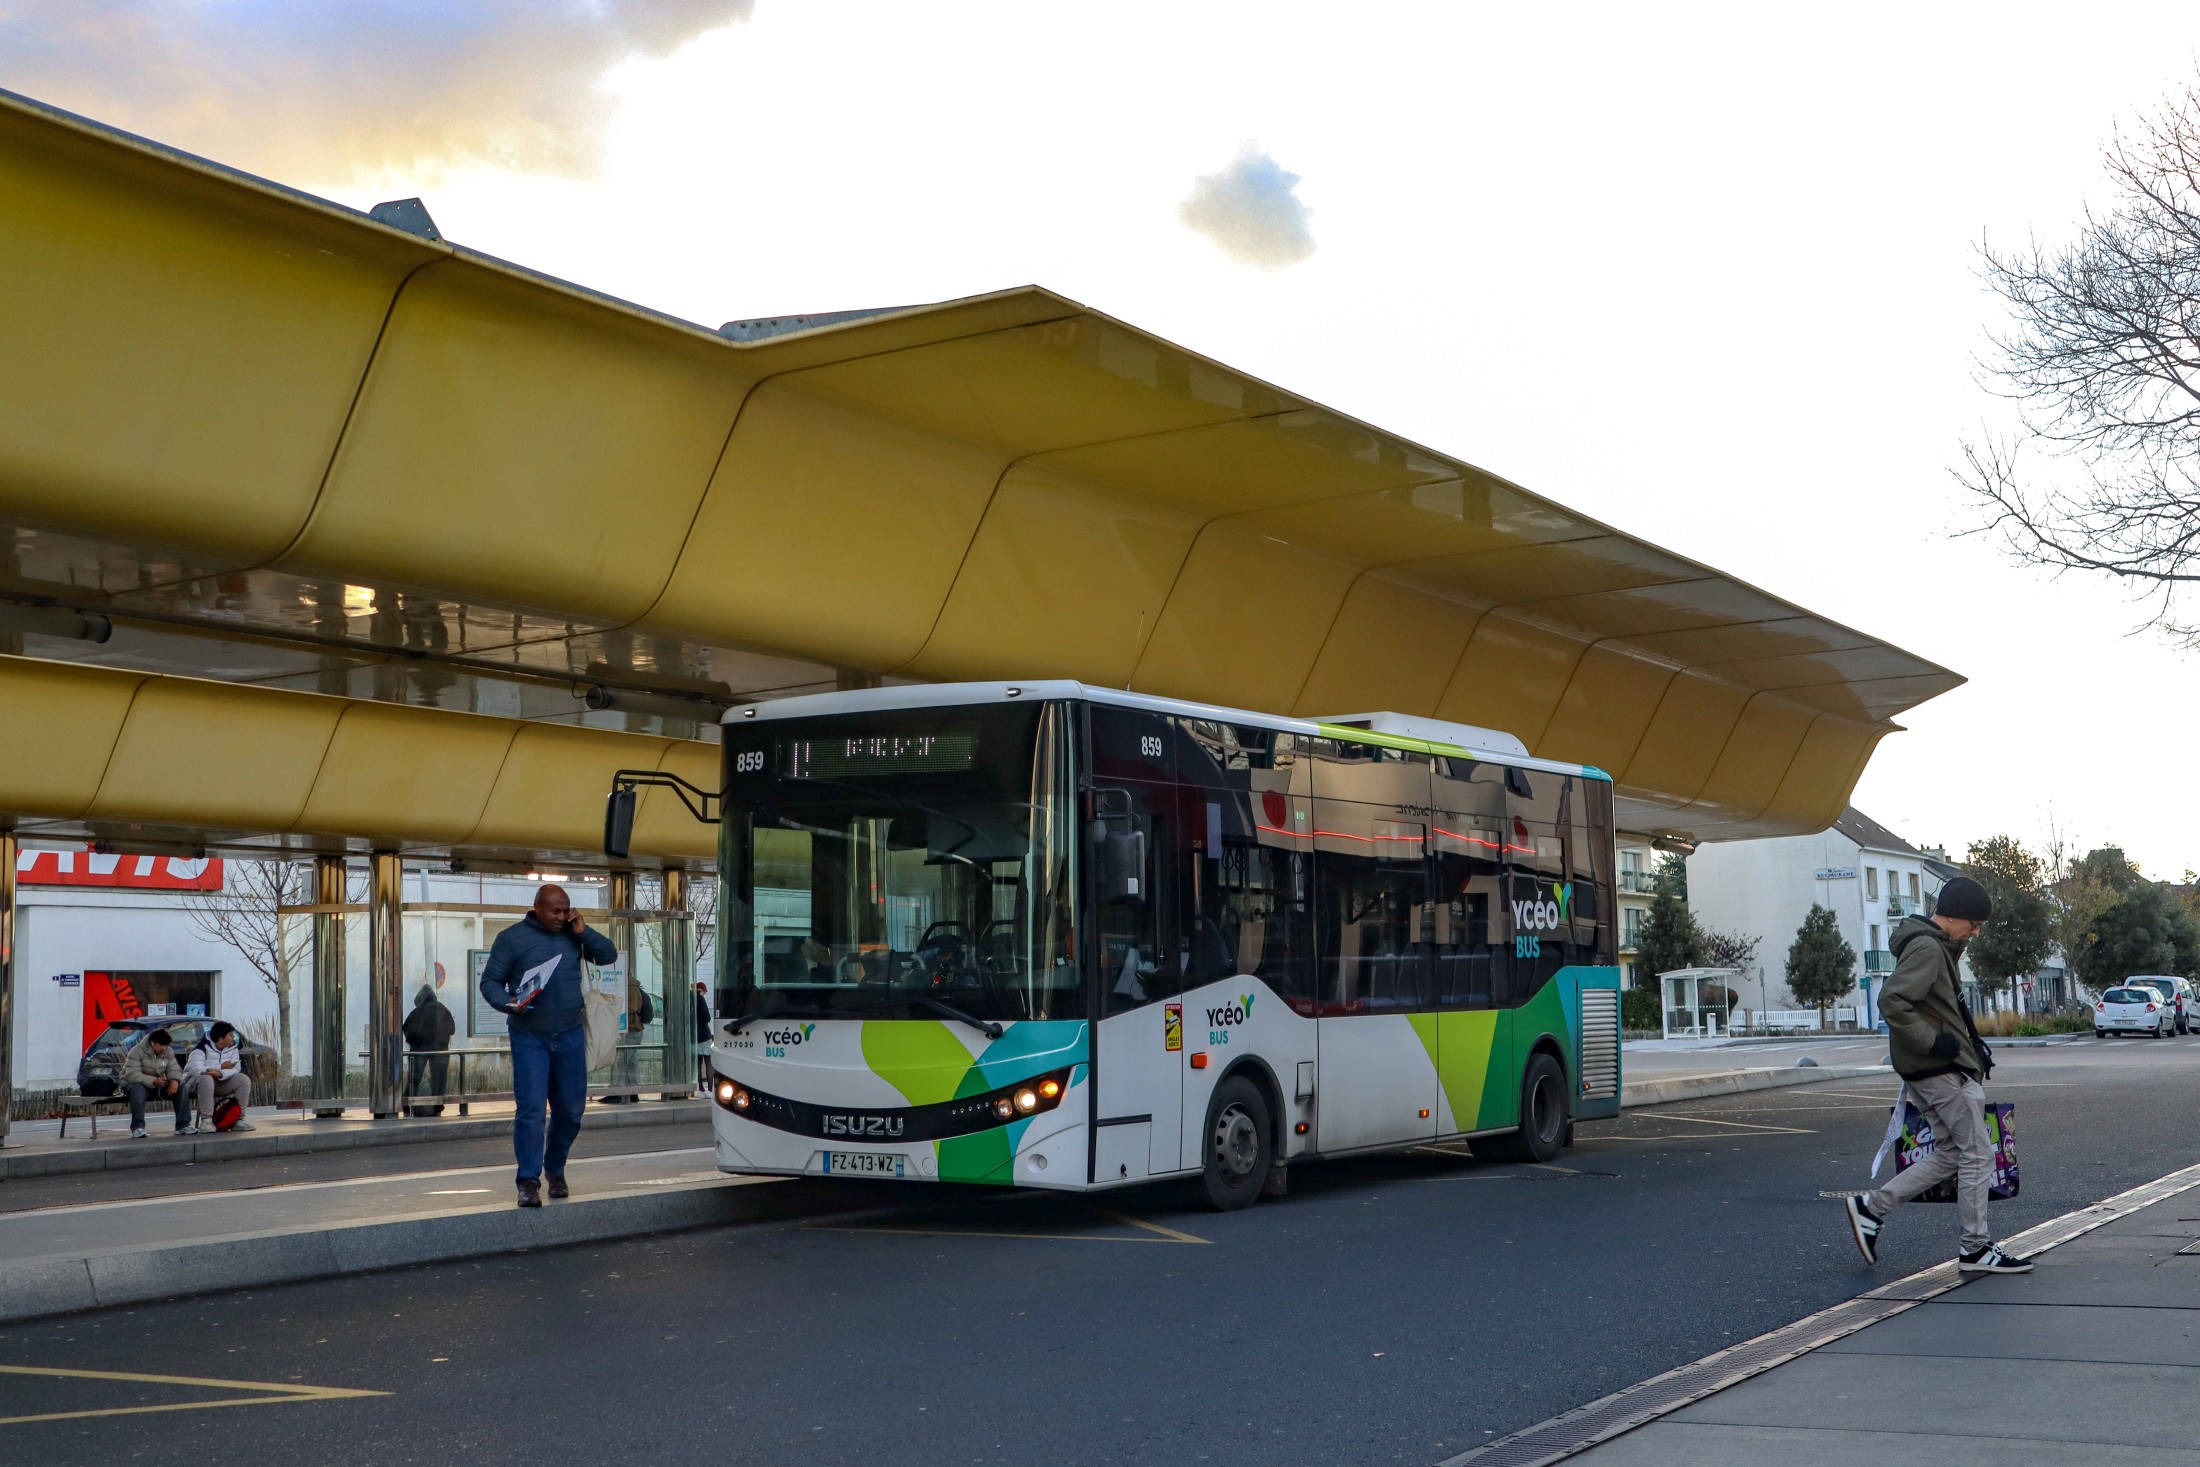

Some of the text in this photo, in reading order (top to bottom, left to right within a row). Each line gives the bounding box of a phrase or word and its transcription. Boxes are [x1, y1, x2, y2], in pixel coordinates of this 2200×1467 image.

[1141, 736, 1162, 757] 859
[737, 751, 764, 772] 859
[1516, 936, 1540, 958] BUS
[111, 978, 144, 1019] AVIS
[1209, 1030, 1229, 1046] BUS
[765, 1047, 785, 1057] BUS
[823, 1114, 903, 1136] ISUZU
[832, 1154, 893, 1172] FZ-473-WZ
